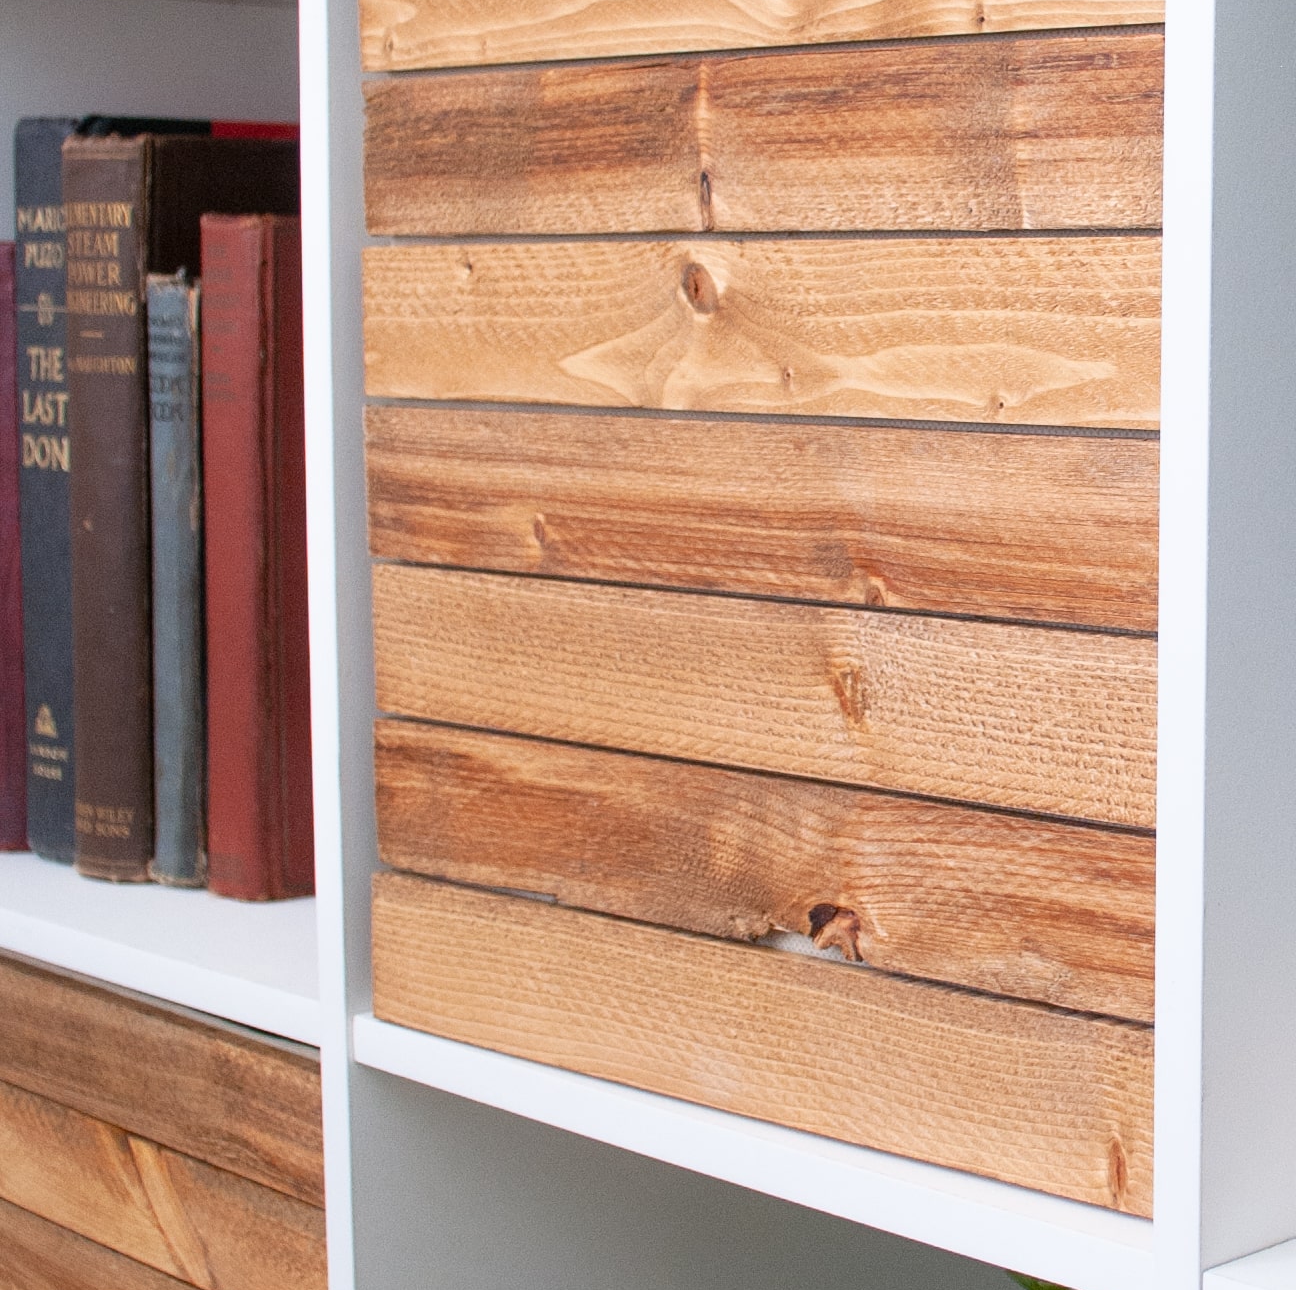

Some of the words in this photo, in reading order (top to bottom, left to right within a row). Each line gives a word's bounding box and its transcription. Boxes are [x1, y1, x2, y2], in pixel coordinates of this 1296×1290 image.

[24, 241, 65, 269] PUZO
[67, 230, 119, 258] STEAM
[26, 345, 64, 383] THE
[22, 388, 69, 427] LAST
[22, 432, 70, 472] DON
